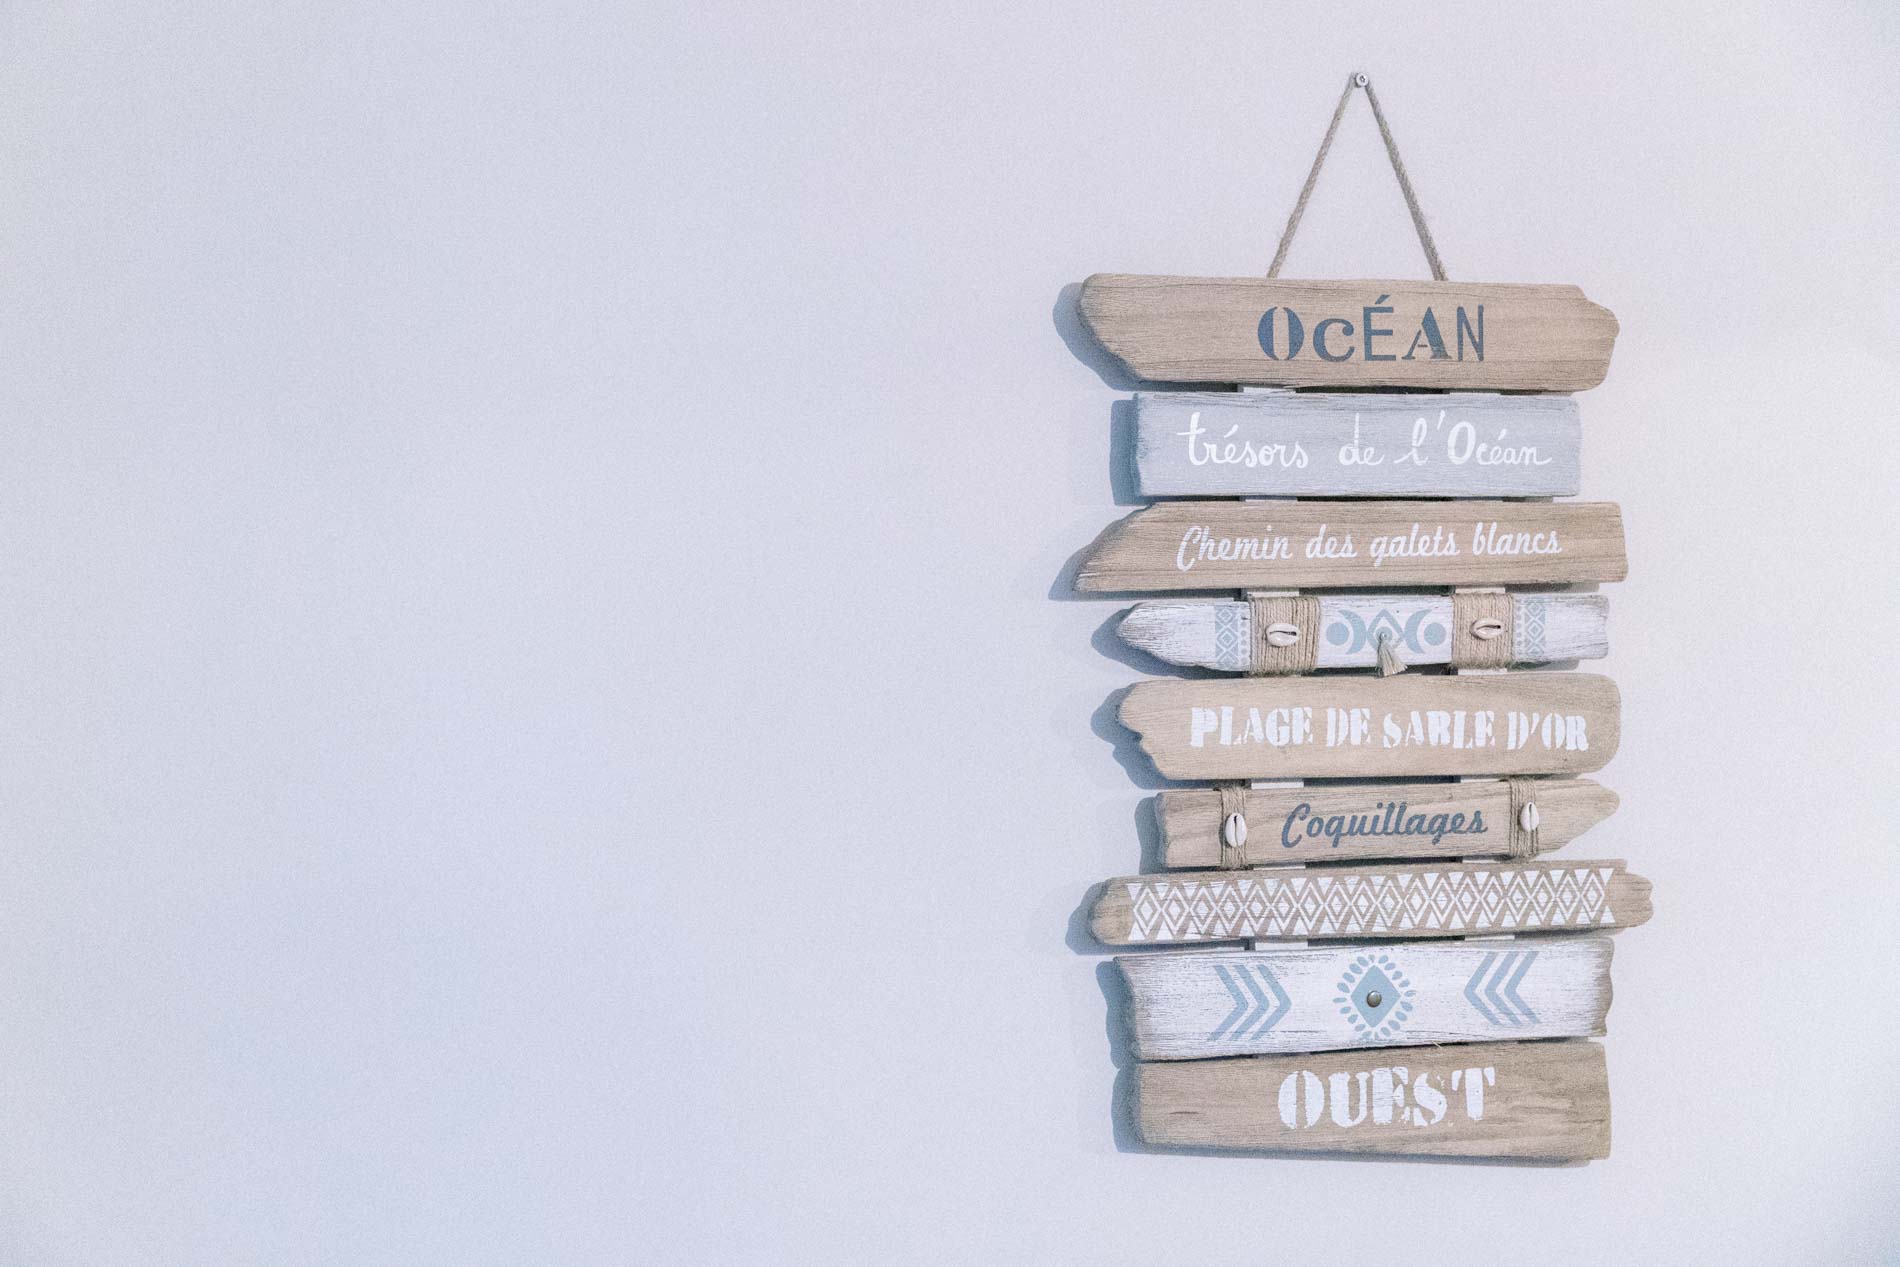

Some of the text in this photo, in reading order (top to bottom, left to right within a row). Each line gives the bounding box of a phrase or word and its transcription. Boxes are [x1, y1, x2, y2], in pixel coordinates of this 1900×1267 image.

[1177, 410, 1553, 469] trésors de l'Océan
[1176, 522, 1563, 572] Chemin des galets blancs
[1189, 706, 1314, 748] PLAGE
[1326, 707, 1372, 748] DE
[1506, 711, 1589, 751] D'OR
[1281, 801, 1488, 848] Coquillages
[1277, 1066, 1495, 1129] OUEST
